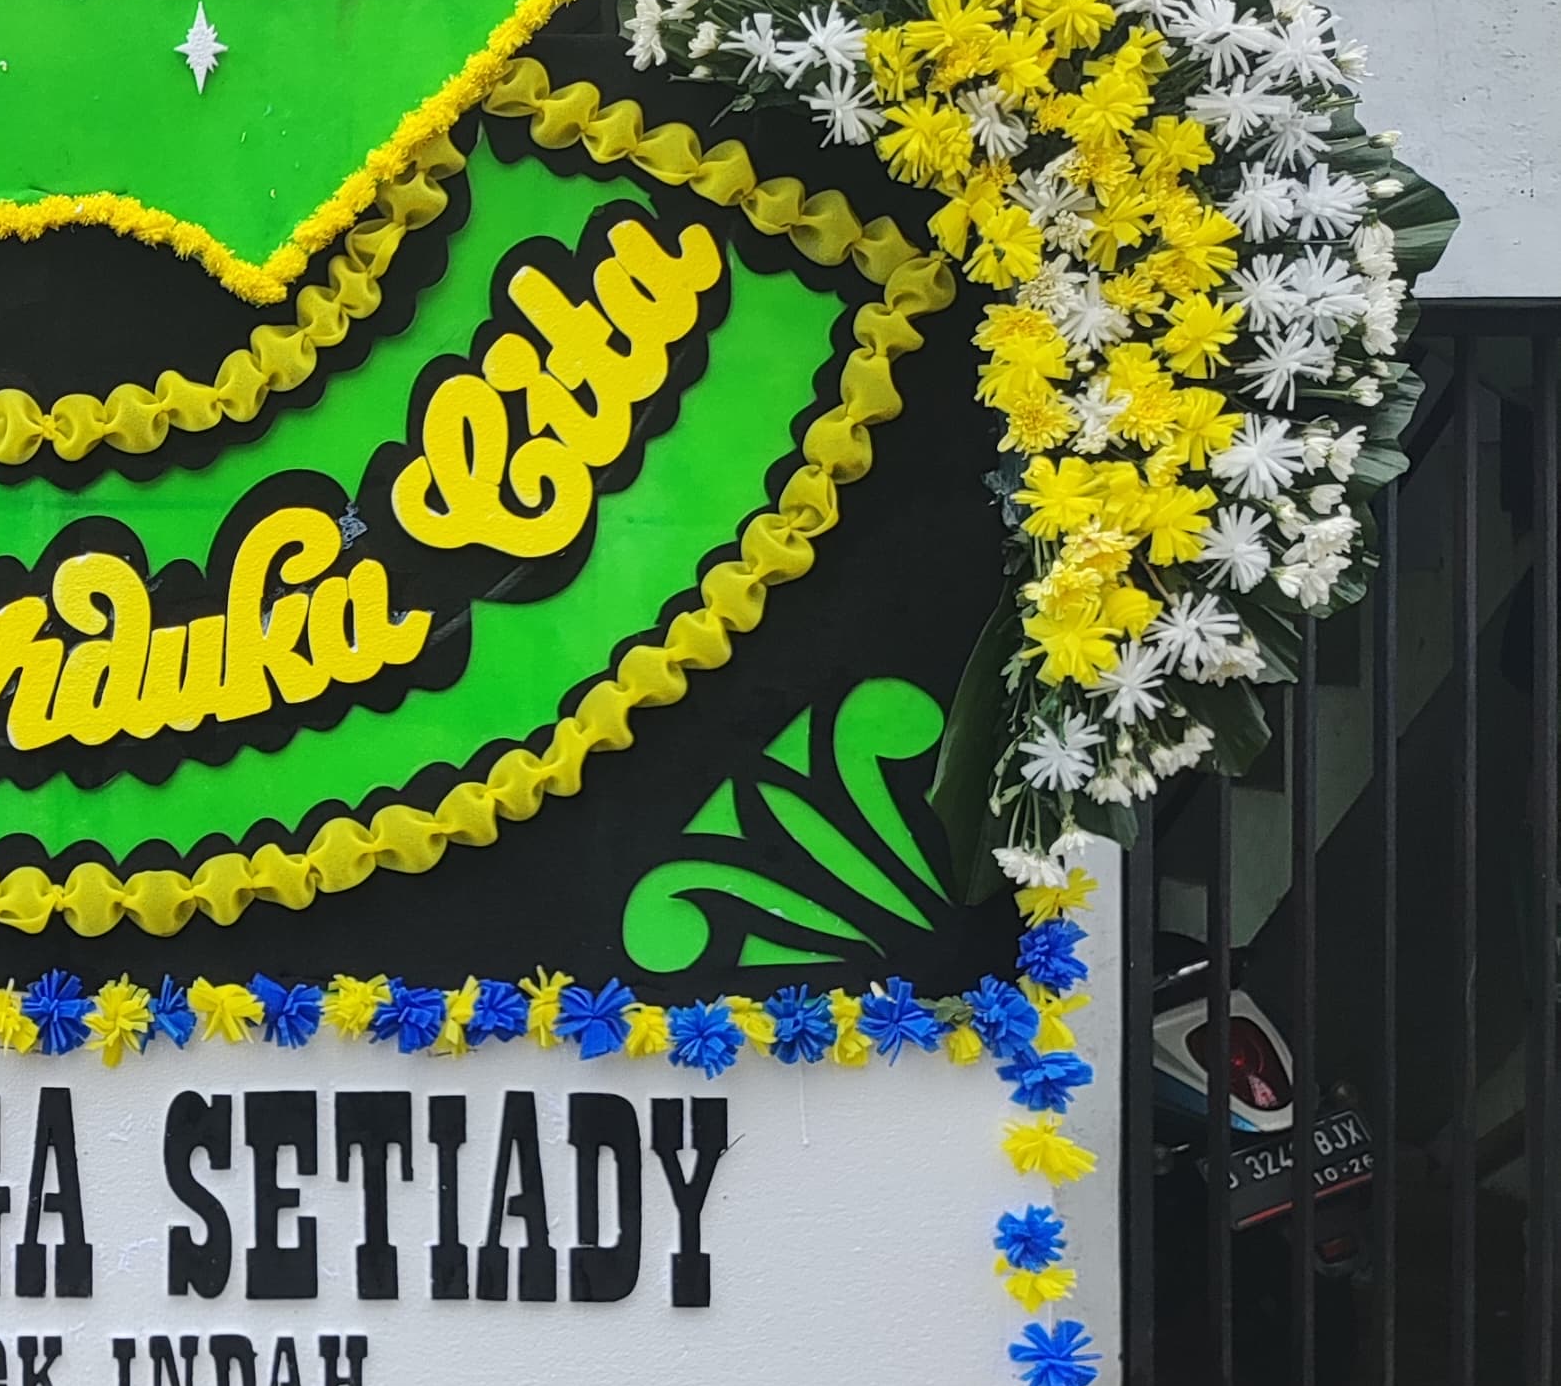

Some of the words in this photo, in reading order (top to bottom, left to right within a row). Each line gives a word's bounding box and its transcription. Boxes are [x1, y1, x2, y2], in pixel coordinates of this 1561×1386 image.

[391, 219, 722, 558] Cita
[163, 1090, 729, 1309] SETIADY
[1313, 1119, 1363, 1155] BJX
